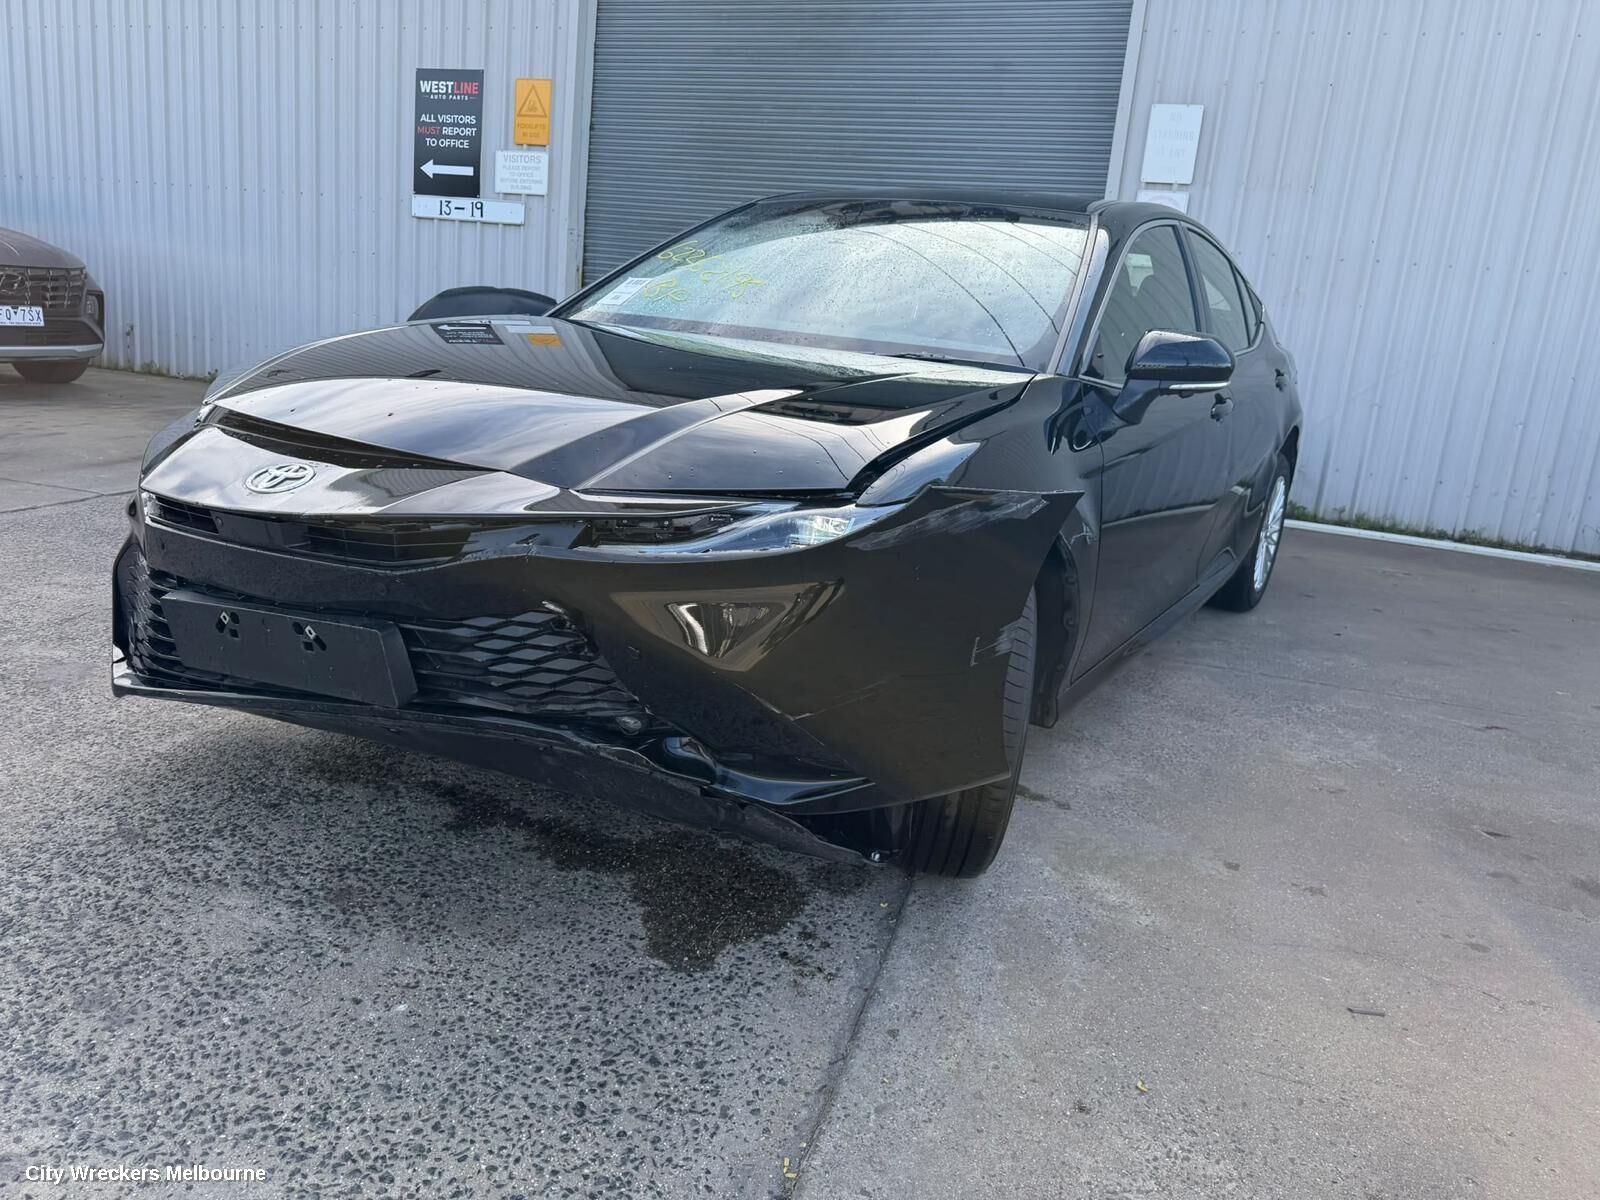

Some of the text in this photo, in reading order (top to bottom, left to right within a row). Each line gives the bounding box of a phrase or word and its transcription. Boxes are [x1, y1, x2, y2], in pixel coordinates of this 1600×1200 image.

[420, 80, 479, 94] WESTLINE
[420, 113, 476, 124] ALL VISITORS
[417, 126, 477, 137] MUST REPORT
[425, 138, 470, 149] TO OFFICE
[503, 153, 542, 164] VISITORS
